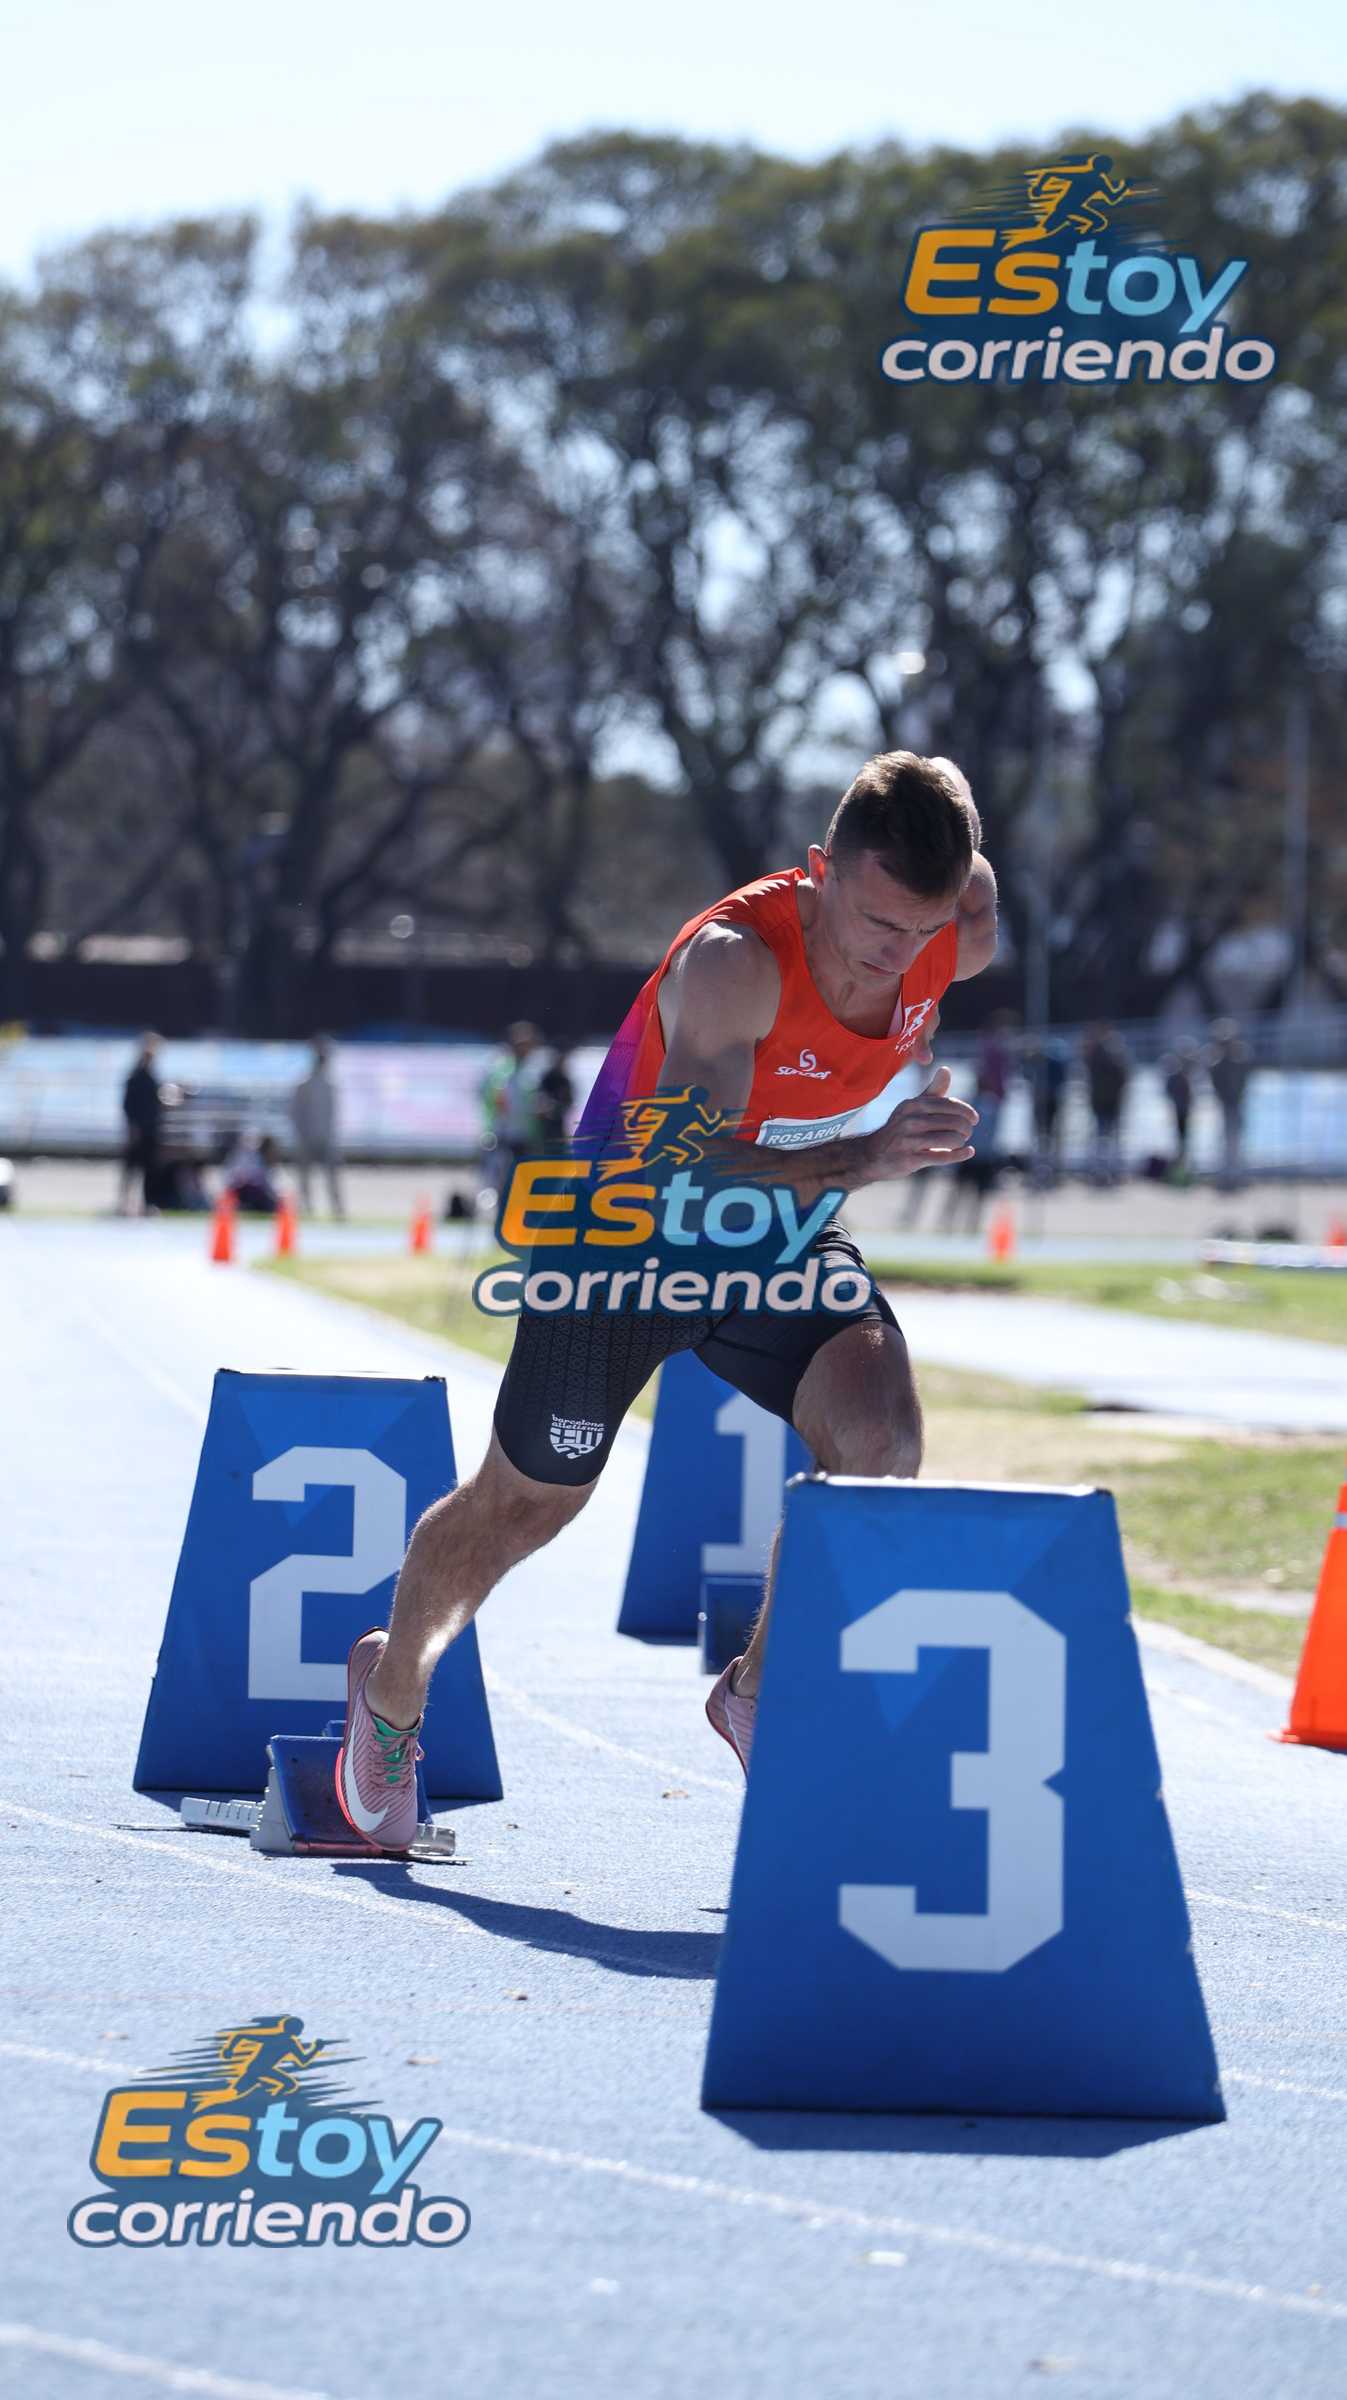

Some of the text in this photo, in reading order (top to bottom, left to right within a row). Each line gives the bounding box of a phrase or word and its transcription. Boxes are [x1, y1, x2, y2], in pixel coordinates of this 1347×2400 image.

[767, 1124, 841, 1145] ROSARIO
[248, 1446, 407, 1702] 2
[702, 1391, 786, 1574] 1
[839, 1589, 1067, 1973] 3
